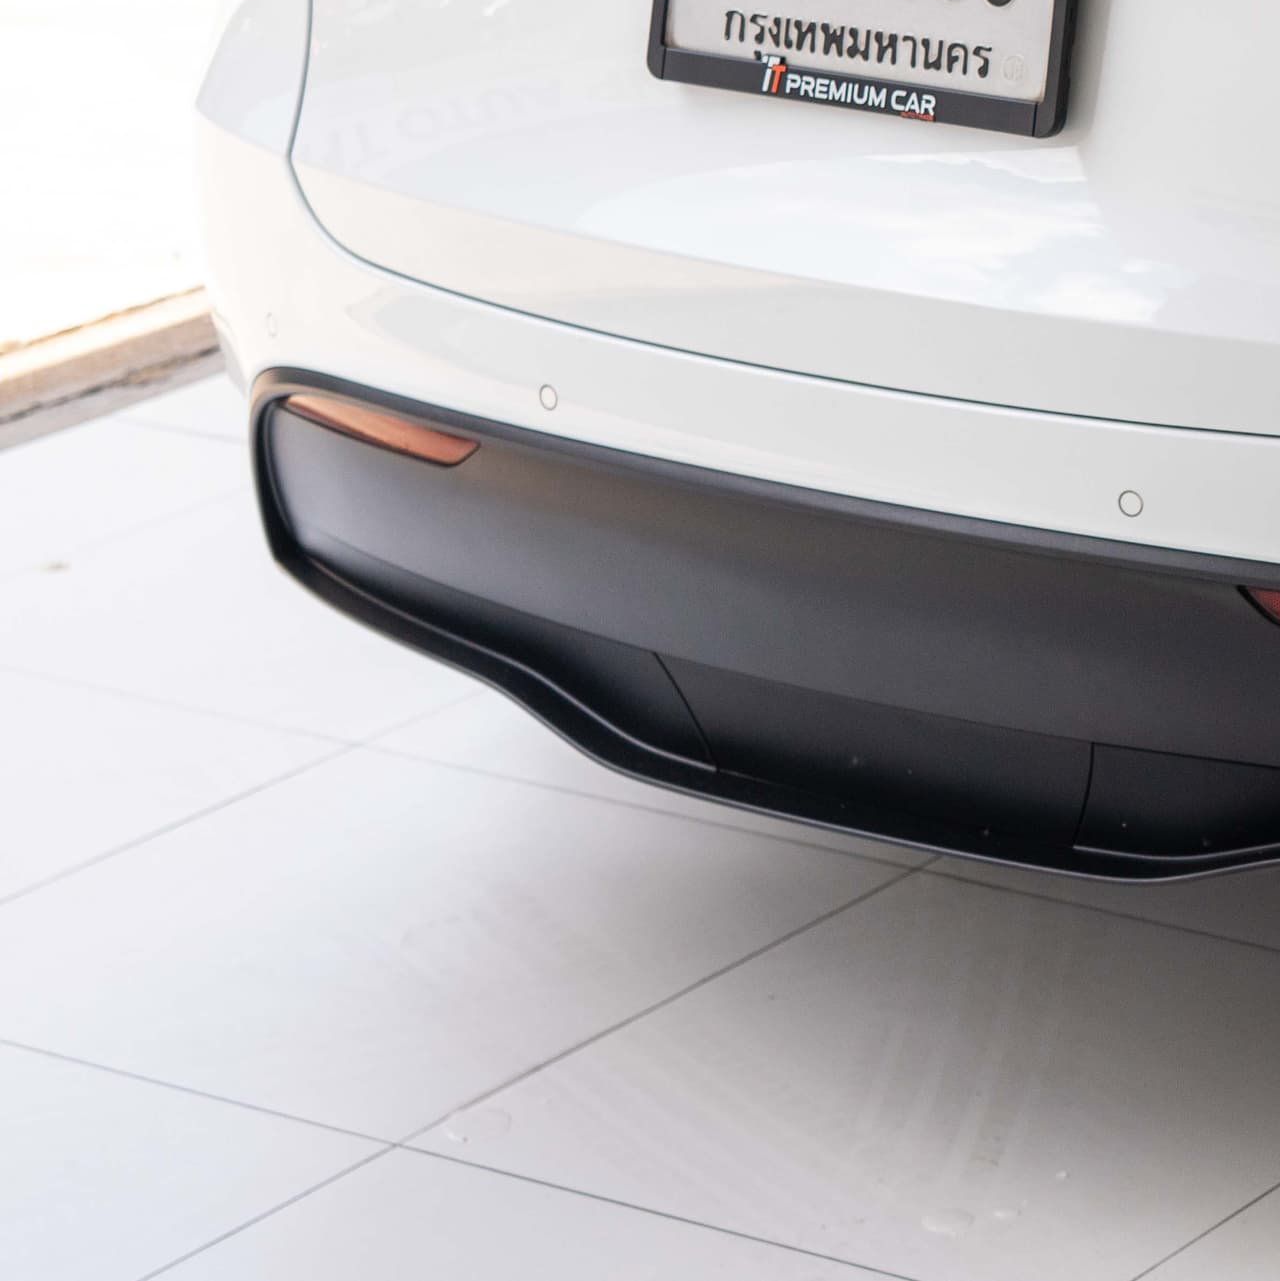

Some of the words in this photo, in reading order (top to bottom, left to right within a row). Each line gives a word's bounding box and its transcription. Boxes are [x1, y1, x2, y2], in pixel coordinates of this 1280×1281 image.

[724, 10, 993, 79] กรุงเทพมหานคร
[785, 73, 888, 110] PREMIUM
[890, 90, 937, 116] CAR
